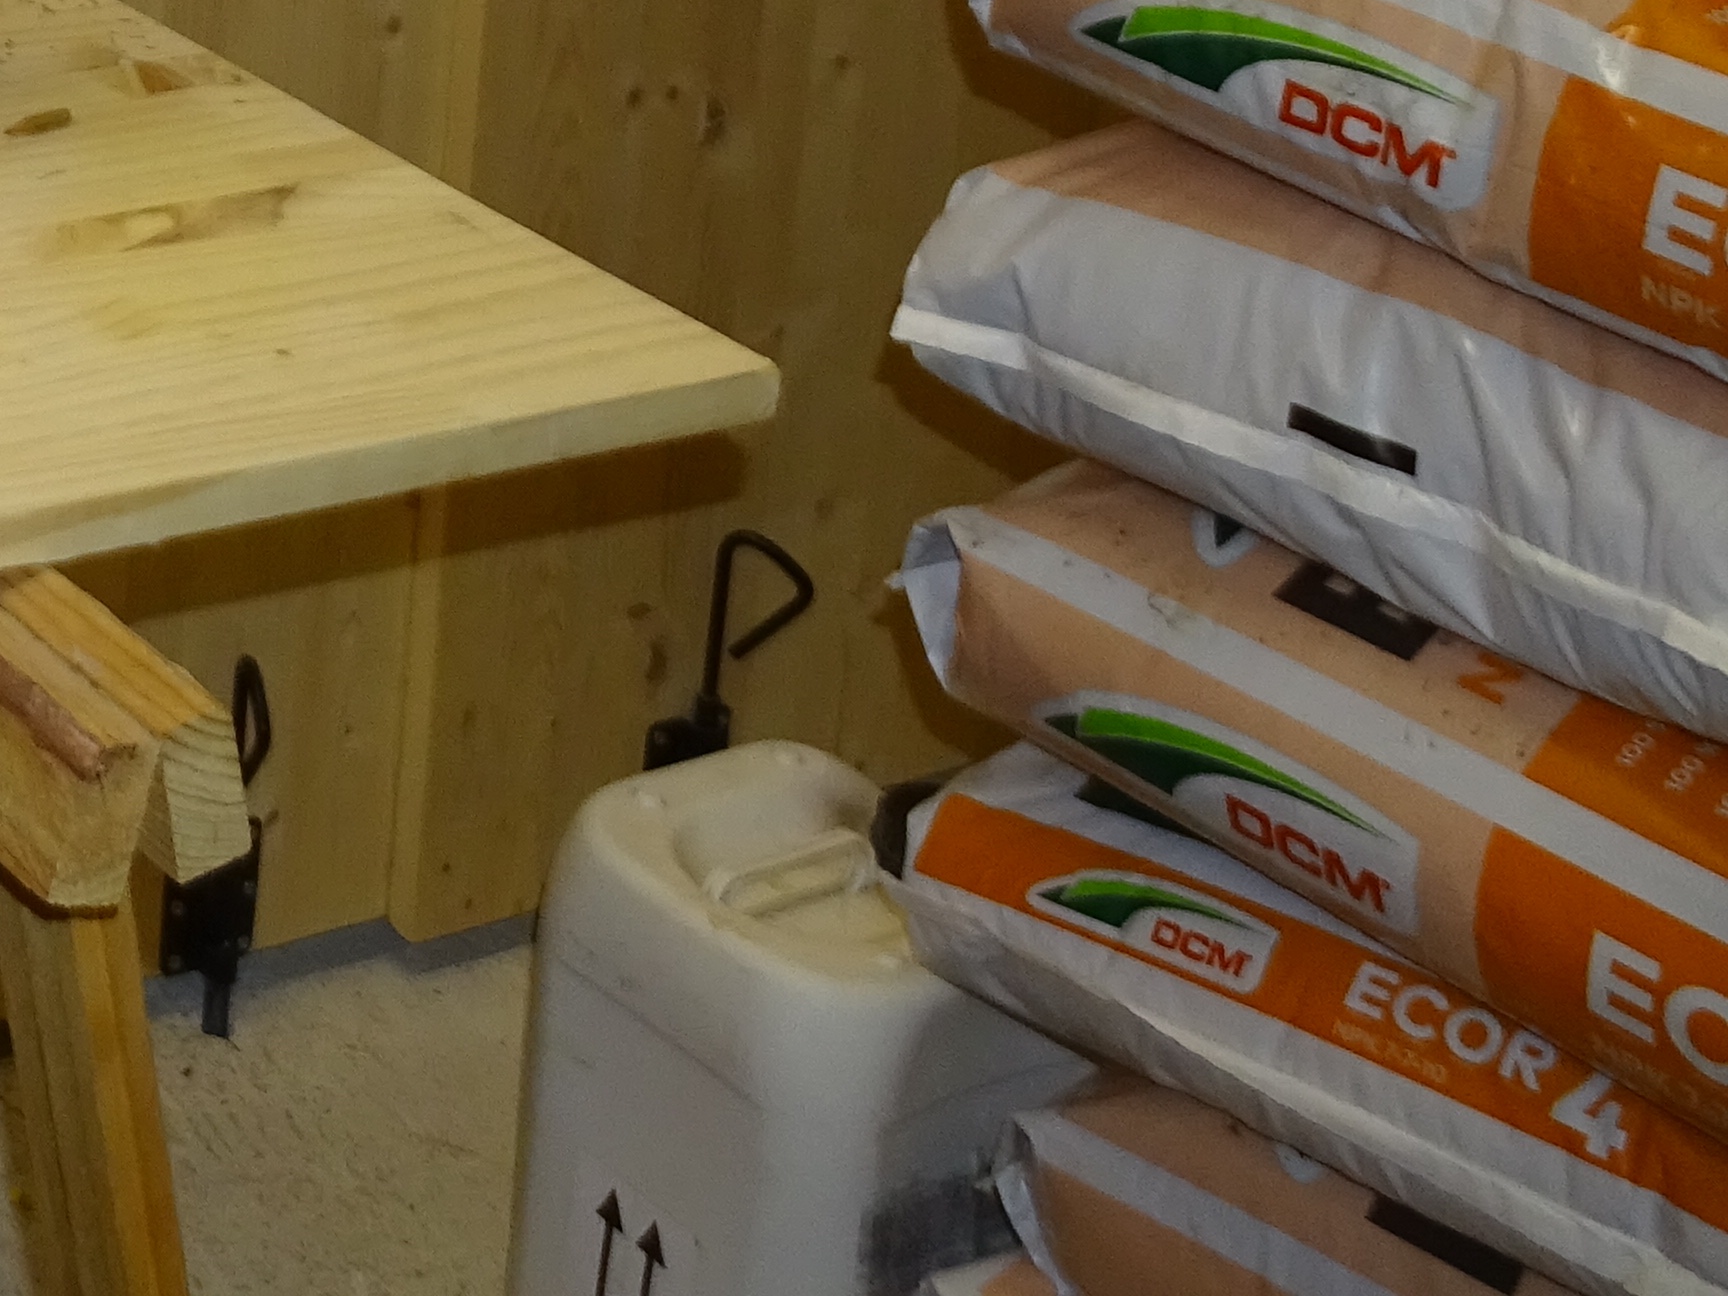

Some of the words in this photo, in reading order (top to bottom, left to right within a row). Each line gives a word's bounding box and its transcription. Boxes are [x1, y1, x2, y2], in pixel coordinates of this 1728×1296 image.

[1278, 78, 1449, 189] DCM
[1225, 793, 1384, 912] DCM
[1151, 916, 1249, 977] DCM
[1344, 960, 1558, 1092] ECOR
[1549, 1072, 1629, 1160] 4
